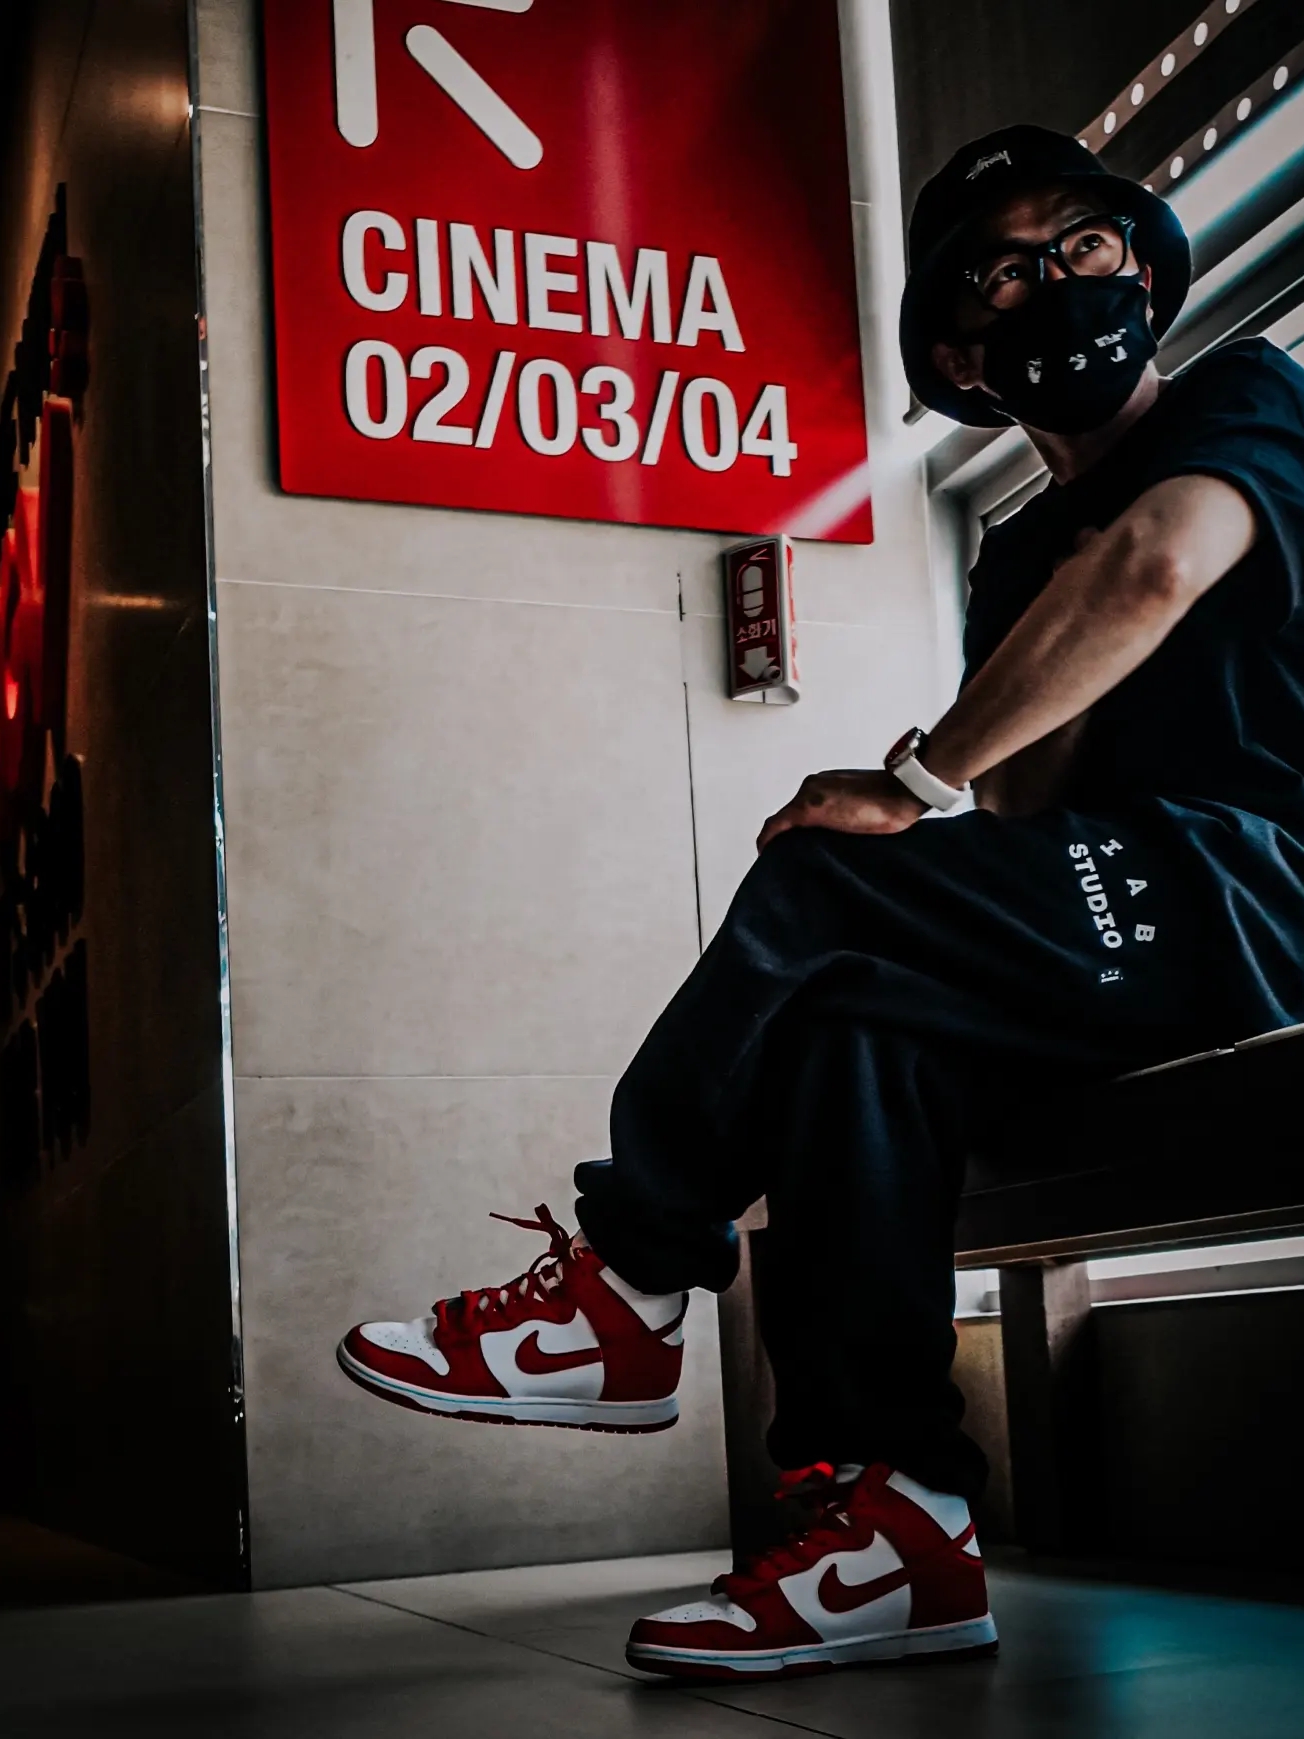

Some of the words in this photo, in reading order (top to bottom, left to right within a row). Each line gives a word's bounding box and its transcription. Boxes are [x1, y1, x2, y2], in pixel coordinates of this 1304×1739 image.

[342, 210, 746, 353] CINEMA
[345, 339, 798, 477] 02/03/04
[736, 618, 777, 643] 소화기
[1068, 843, 1123, 949] STUDIO
